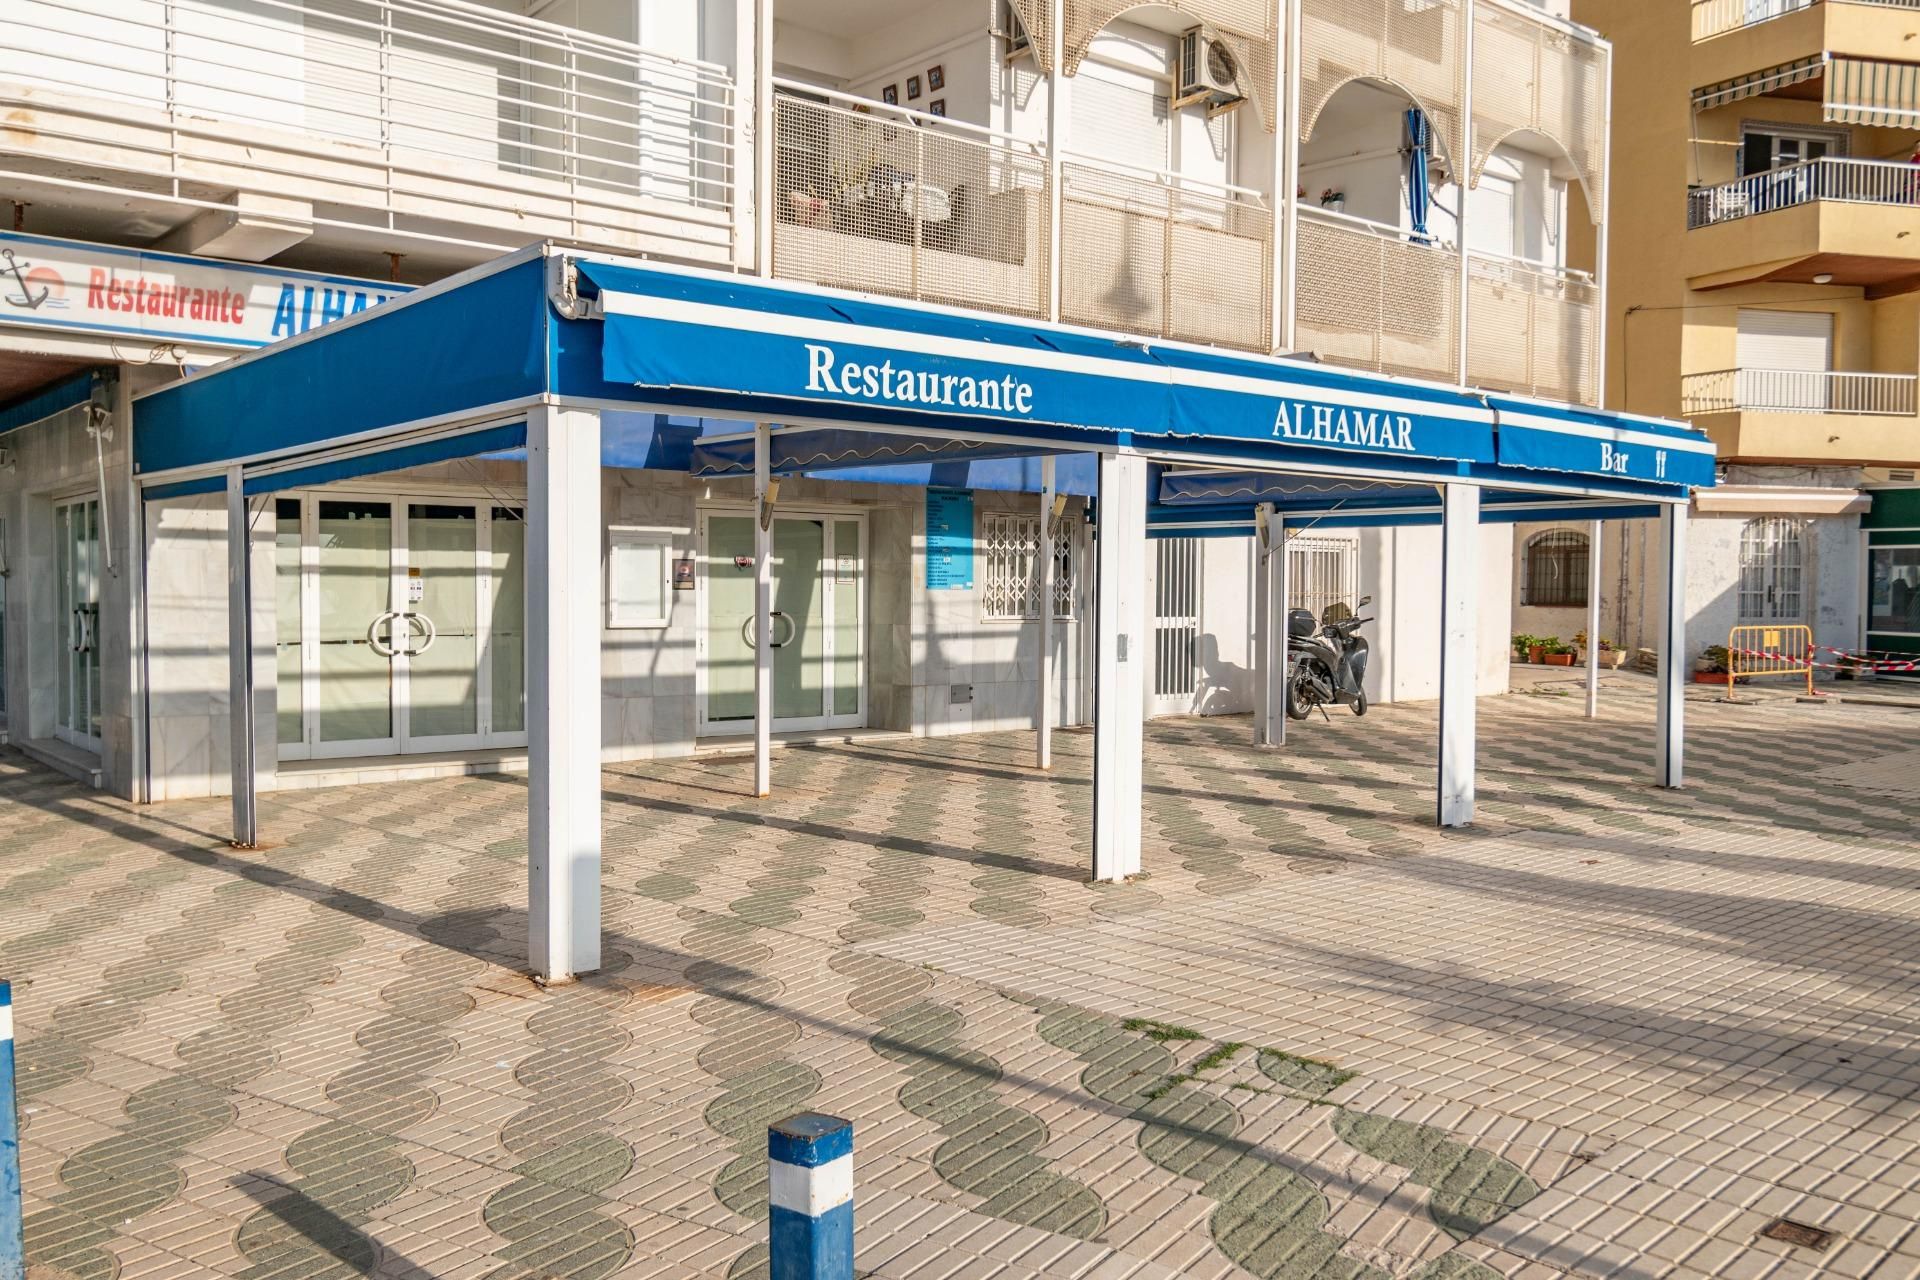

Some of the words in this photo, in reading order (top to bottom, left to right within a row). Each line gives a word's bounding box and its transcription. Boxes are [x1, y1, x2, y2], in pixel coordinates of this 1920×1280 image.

[88, 267, 245, 324] Restaurante
[271, 283, 395, 338] ALH
[804, 344, 1033, 413] Restaurante
[1272, 400, 1416, 451] ALHAMAR
[1600, 442, 1629, 473] Bar
